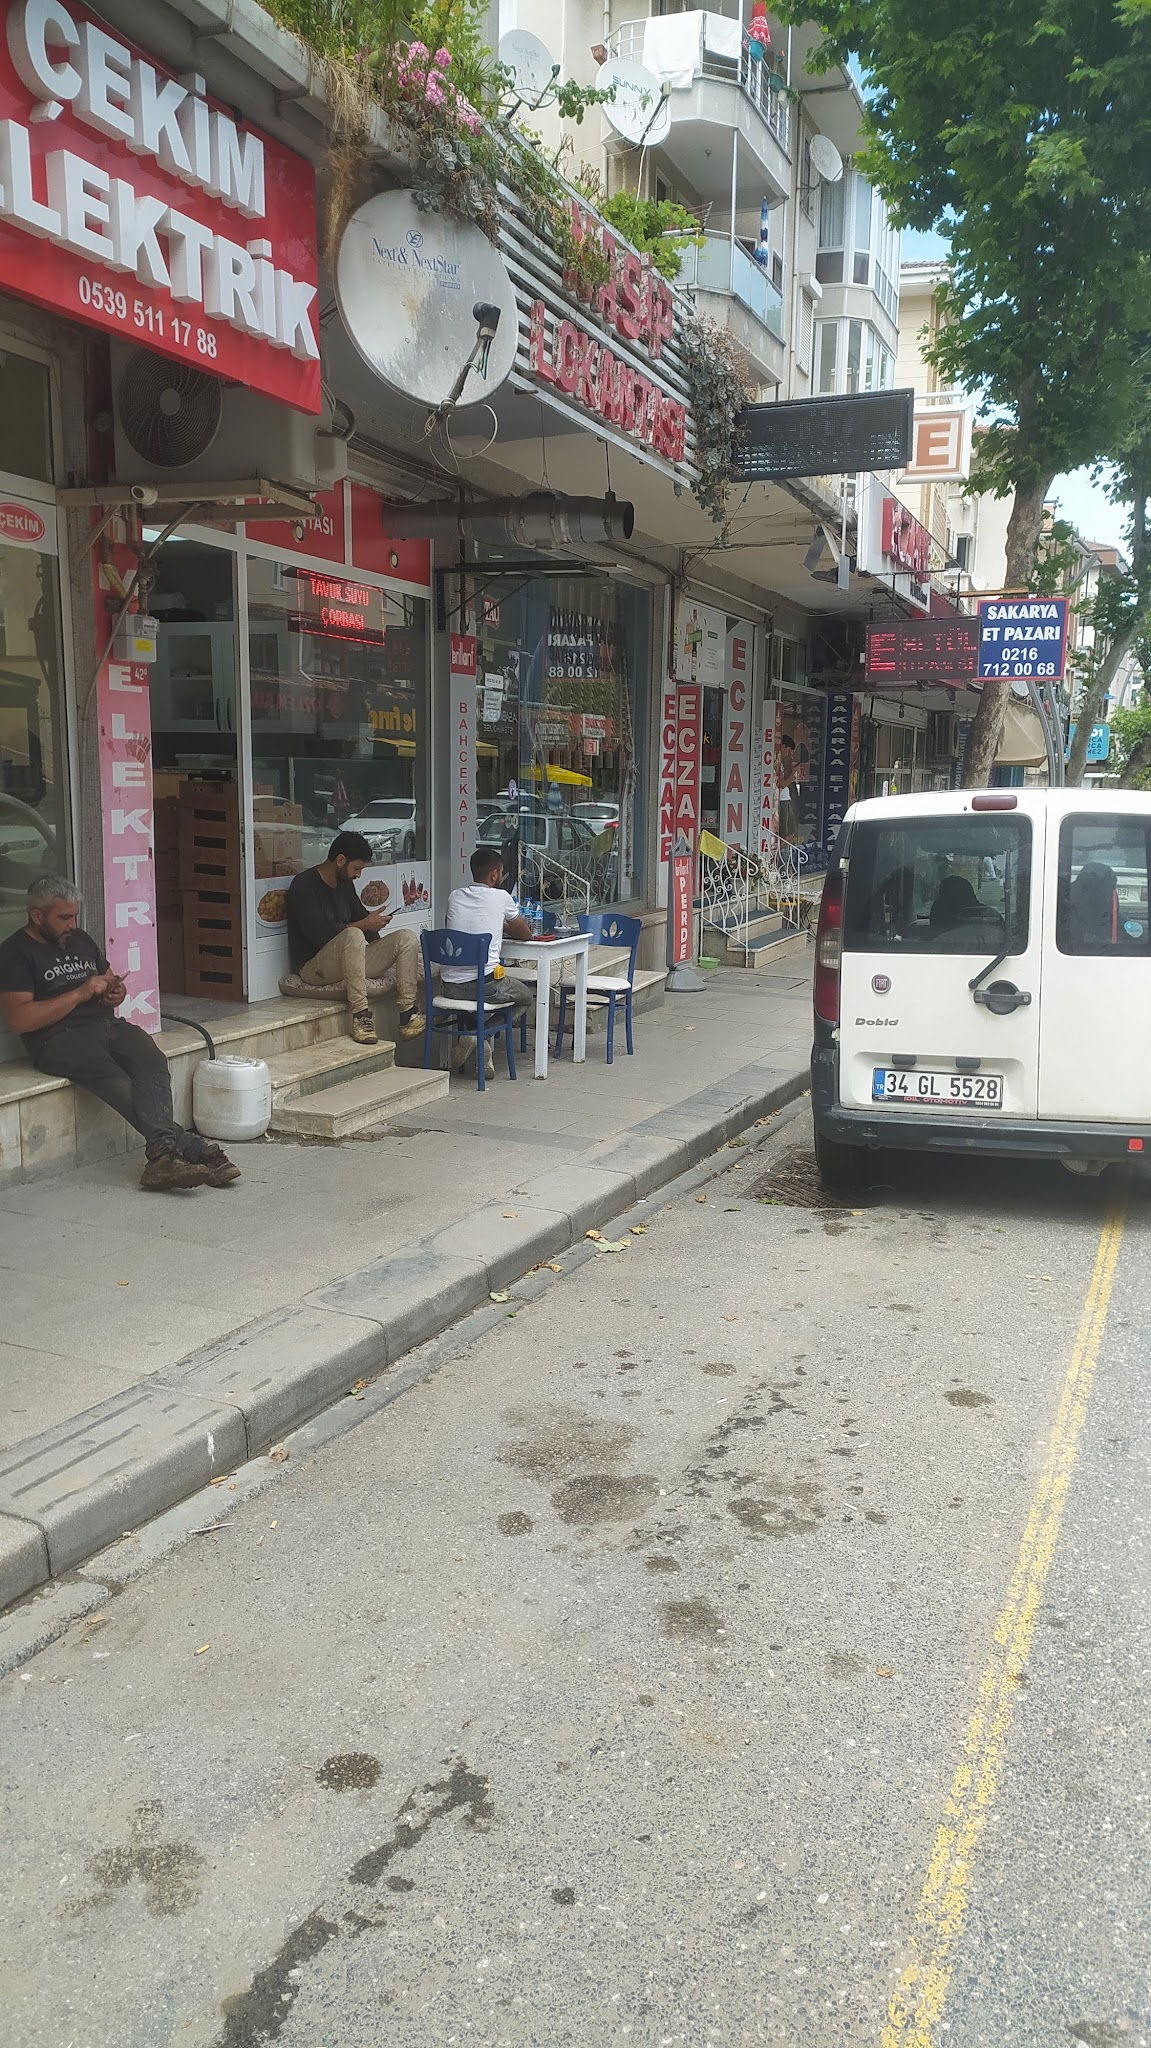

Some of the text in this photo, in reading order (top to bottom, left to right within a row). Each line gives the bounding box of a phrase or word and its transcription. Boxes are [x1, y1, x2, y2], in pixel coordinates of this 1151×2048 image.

[612, 75, 652, 95] SUNNY
[7, 0, 266, 219] ÇEKİM
[0, 119, 321, 361] LEKTRİK
[372, 238, 397, 262] Next
[397, 247, 408, 265] &
[412, 249, 460, 275] NextStar
[78, 275, 218, 359] 0539 511 17 88
[916, 422, 951, 467] E
[309, 578, 370, 607] TAVUK SUYU
[987, 604, 1059, 620] SAKARYA
[982, 626, 1061, 642] ET PAZARI
[1001, 647, 1038, 661] 0216
[983, 662, 1055, 676] 712 00 68
[828, 695, 848, 766] SAKARYA
[458, 702, 469, 874] BAHCEKAPILI
[661, 694, 676, 863] ECZANE
[676, 695, 697, 853] ECZAN
[829, 775, 844, 793] ET
[108, 664, 157, 1018] ELEKTRİK
[679, 877, 688, 960] PERDE
[876, 1073, 998, 1100] TR 34 GL 5528
